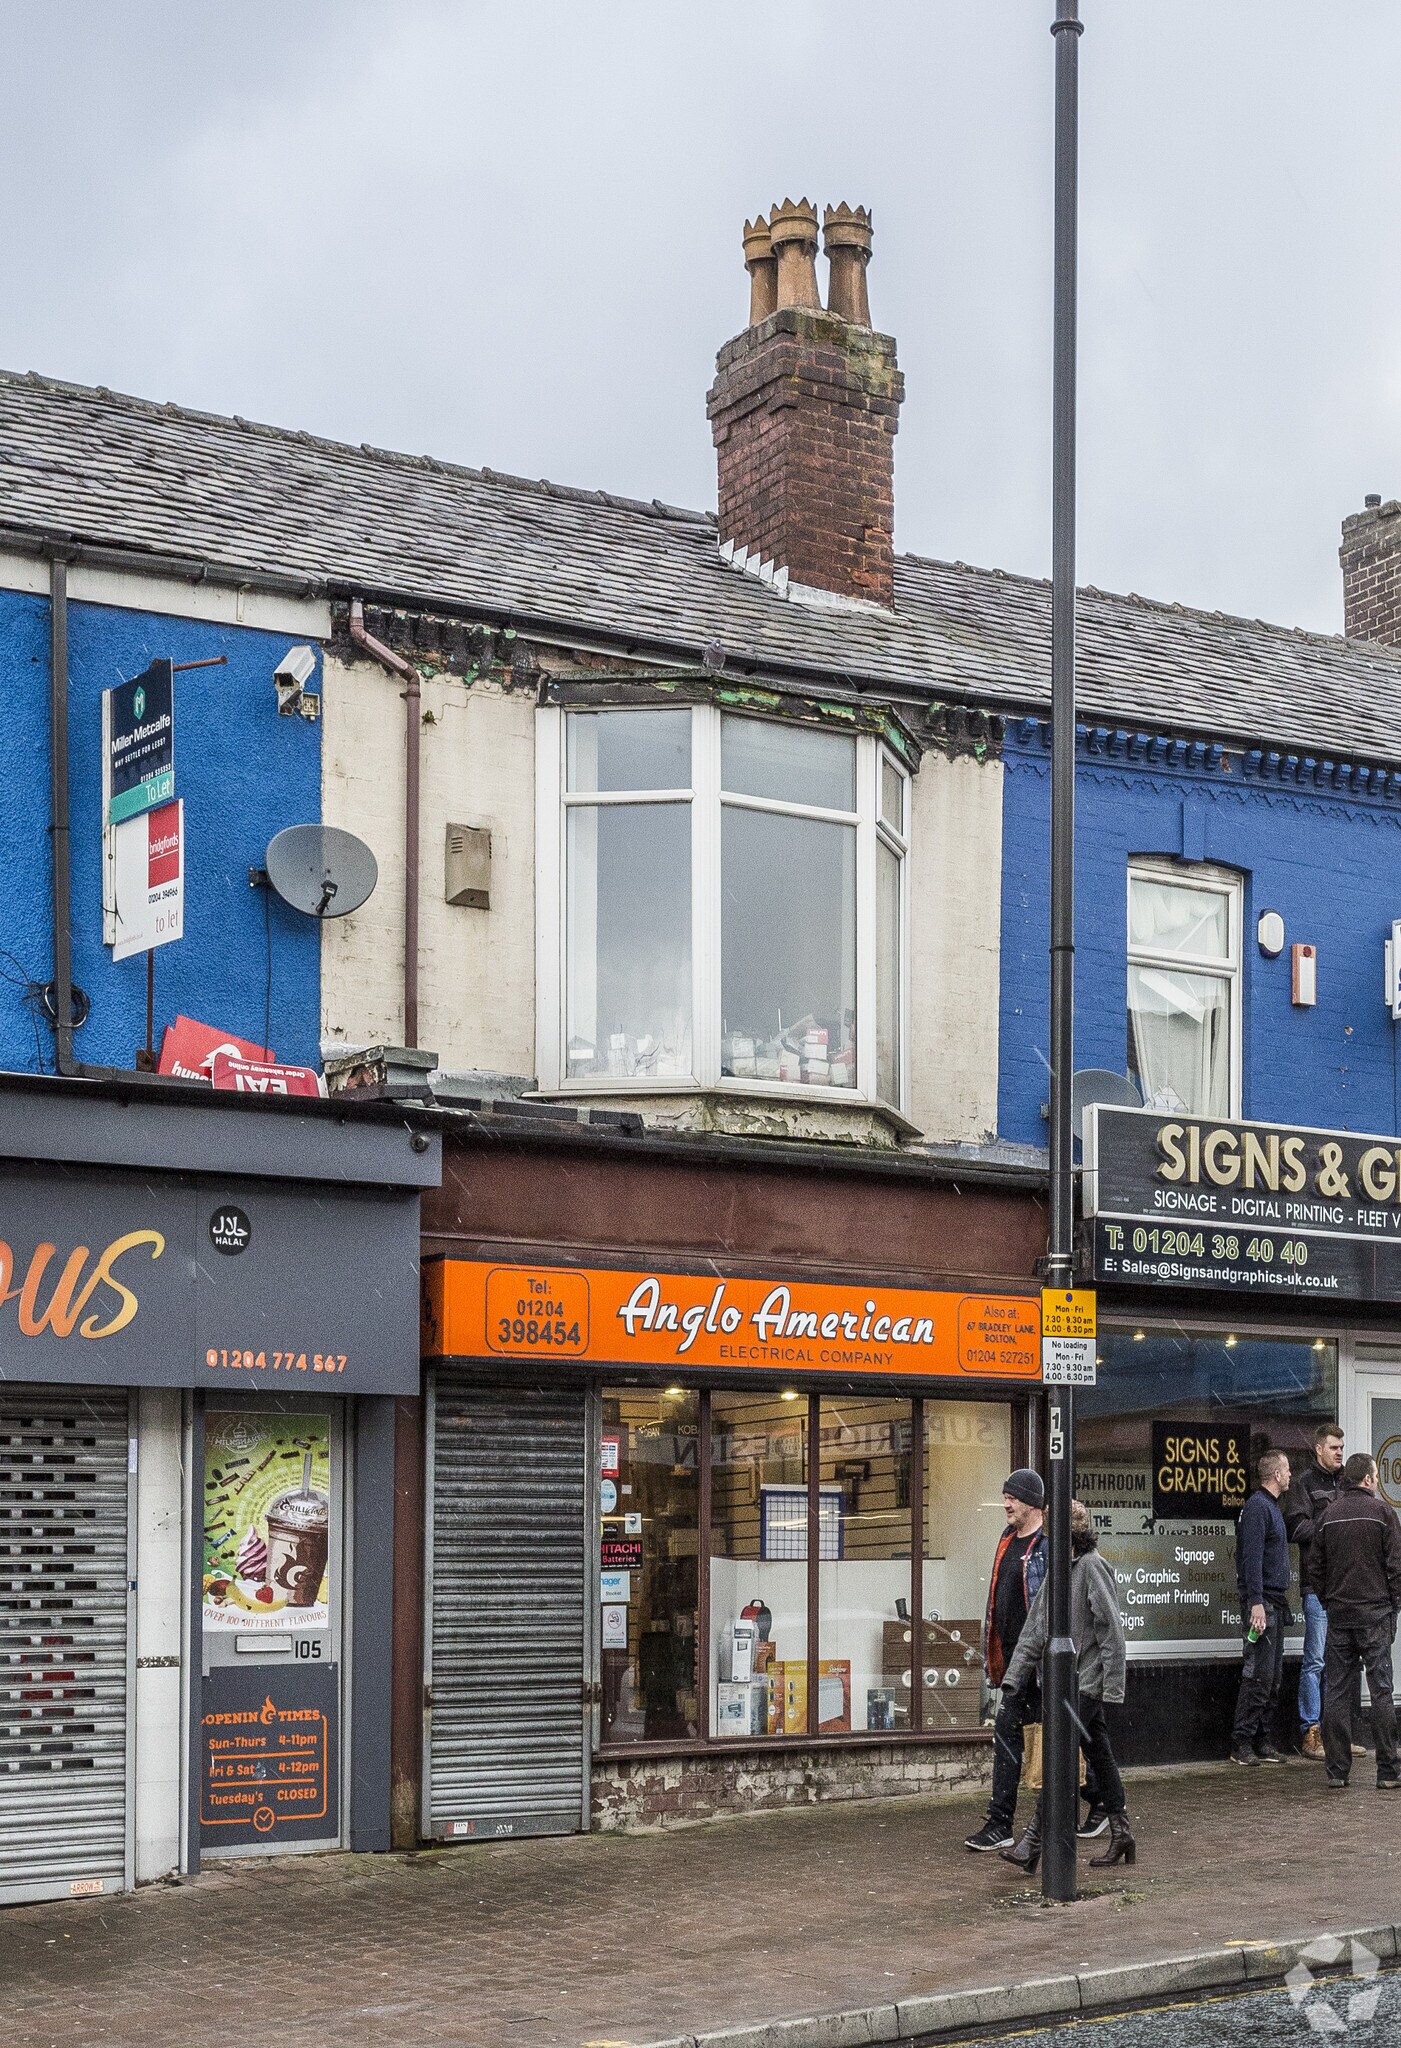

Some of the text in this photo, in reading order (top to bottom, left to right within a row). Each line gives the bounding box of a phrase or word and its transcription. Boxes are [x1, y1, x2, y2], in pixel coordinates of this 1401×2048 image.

[111, 713, 171, 755] Miller Metcalfe
[125, 748, 141, 763] SETTLE
[141, 744, 151, 755] FOR
[145, 777, 171, 802] To Let
[148, 831, 179, 856] bridgfords
[155, 909, 178, 933] to let
[228, 1060, 306, 1079] Order takeaway online
[1156, 1123, 1401, 1204] SIGNS & G
[1154, 1190, 1217, 1214] SIGNAGE
[1231, 1197, 1281, 1220] DIGITAL
[1285, 1203, 1344, 1225] PRINTING
[1357, 1209, 1388, 1228] FLEET
[212, 1215, 249, 1238] حلال
[215, 1236, 244, 1247] HALAL
[1105, 1225, 1308, 1266] T: 01204 38 40 40
[1103, 1258, 1338, 1289] E: Sales@Signsandgraphics-uk.co.uk
[527, 1278, 553, 1295] Tel:
[516, 1299, 564, 1318] 01204
[616, 1276, 935, 1355] Anglo American
[983, 1305, 1020, 1319] Also at:
[1055, 1305, 1069, 1313] Mon
[966, 1321, 976, 1331] 67
[977, 1321, 1011, 1334] BRADLEY
[1045, 1315, 1061, 1323] 7.30
[1066, 1315, 1082, 1324] 9.30
[498, 1317, 581, 1346] 398454
[1045, 1324, 1062, 1333] 4.00
[1066, 1325, 1082, 1334] 6.30
[1083, 1327, 1094, 1335] pm
[719, 1344, 894, 1366] ELECTRICAL COMPANY
[1051, 1341, 1088, 1351] No loading
[206, 1349, 348, 1373] 01204 774 567
[966, 1350, 1035, 1365] 01204 527251
[1055, 1353, 1069, 1361] Mon
[1075, 1353, 1084, 1361] Fri
[1045, 1363, 1061, 1371] 7.30
[1066, 1363, 1082, 1372] 9.30
[1045, 1372, 1062, 1381] 4.00
[1066, 1373, 1082, 1381] 6.30
[1083, 1375, 1094, 1383] pm
[677, 1424, 700, 1435] KOB
[1165, 1437, 1240, 1463] SIGNS &
[1157, 1466, 1246, 1493] GRAPHICS
[1222, 1495, 1245, 1506] Bolton
[1093, 1515, 1112, 1528] THE
[1190, 1525, 1226, 1536] 388488
[602, 1555, 637, 1563] Batteries
[1174, 1547, 1215, 1565] Signage
[1136, 1568, 1180, 1587] Graphics
[1188, 1569, 1225, 1582] Banners
[1126, 1589, 1171, 1605] Garment
[1174, 1588, 1210, 1606] Printing
[204, 1608, 327, 1628] OVER 100 DIFFERENT FLAVOURS
[1221, 1609, 1243, 1625] Flee
[295, 1640, 321, 1659] 105
[277, 1709, 320, 1722] TIMES
[208, 1733, 318, 1750] Sun-Thurs 4-11pm
[209, 1761, 320, 1777] Fri & Sat 4-12pm
[209, 1787, 318, 1805] Tuesday's CLOSED
